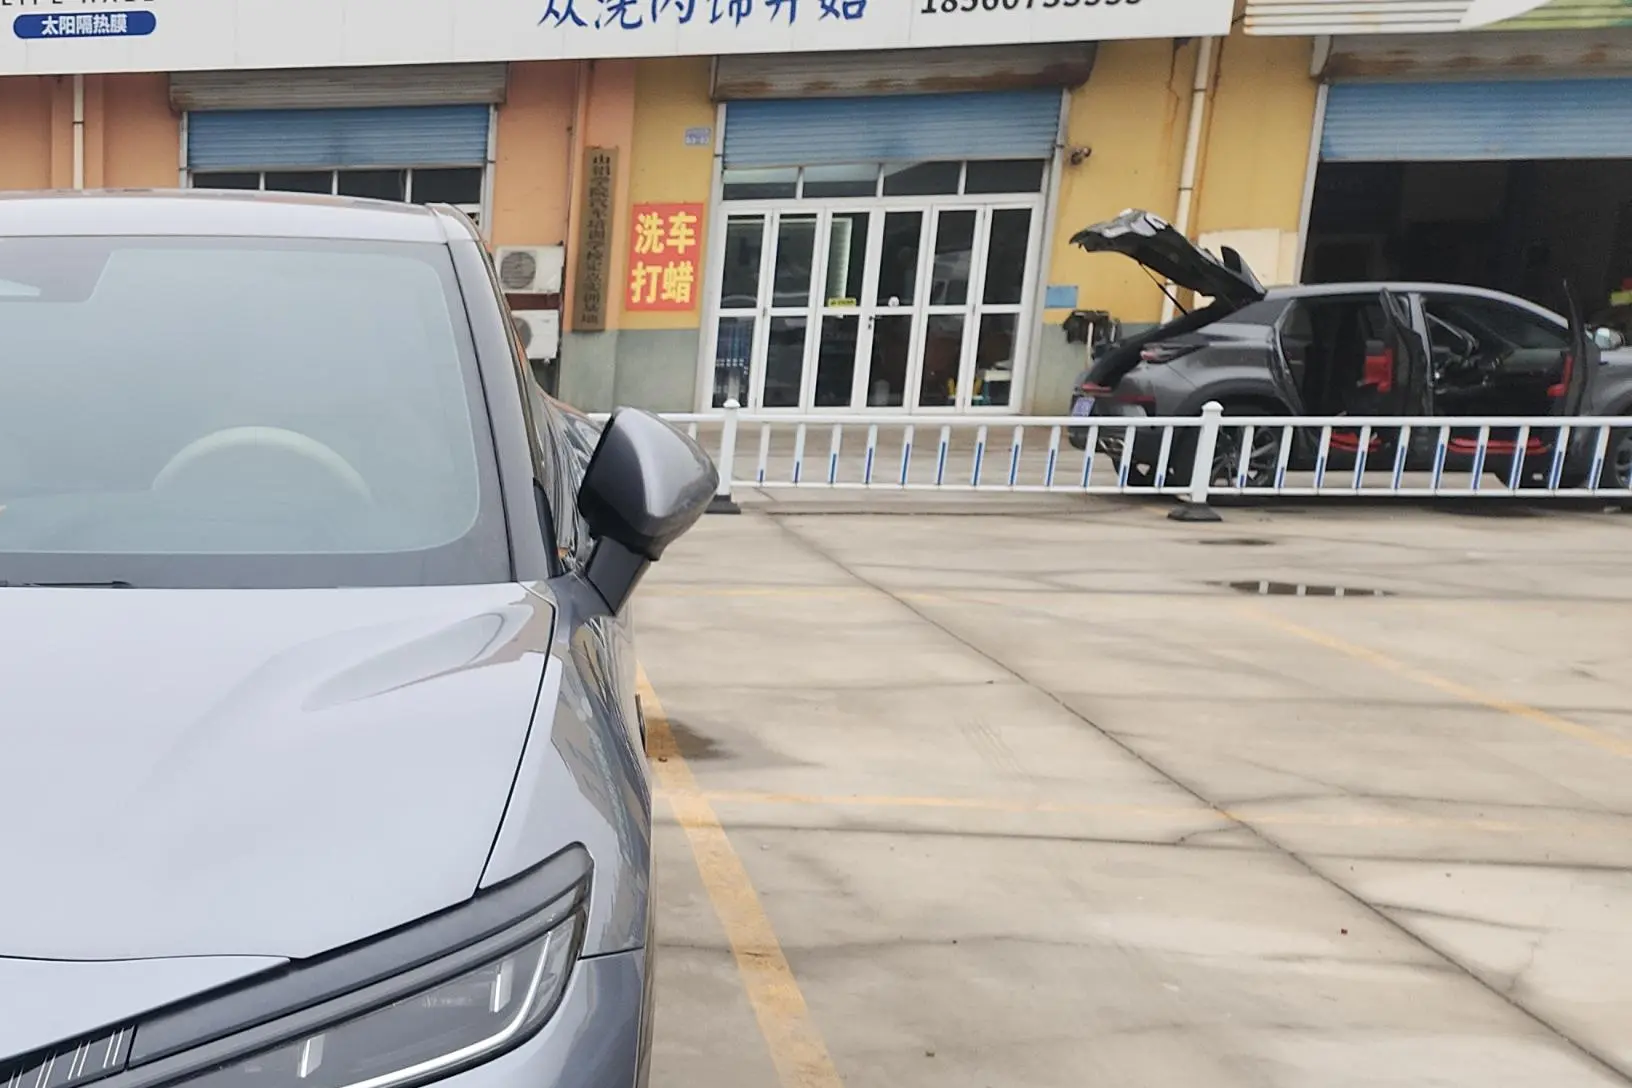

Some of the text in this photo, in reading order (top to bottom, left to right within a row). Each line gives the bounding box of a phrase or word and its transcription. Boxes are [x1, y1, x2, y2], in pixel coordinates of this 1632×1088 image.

[40, 13, 128, 36] 太阳隔热膜
[634, 211, 698, 255] 洗车
[629, 260, 695, 304] 打蜡
